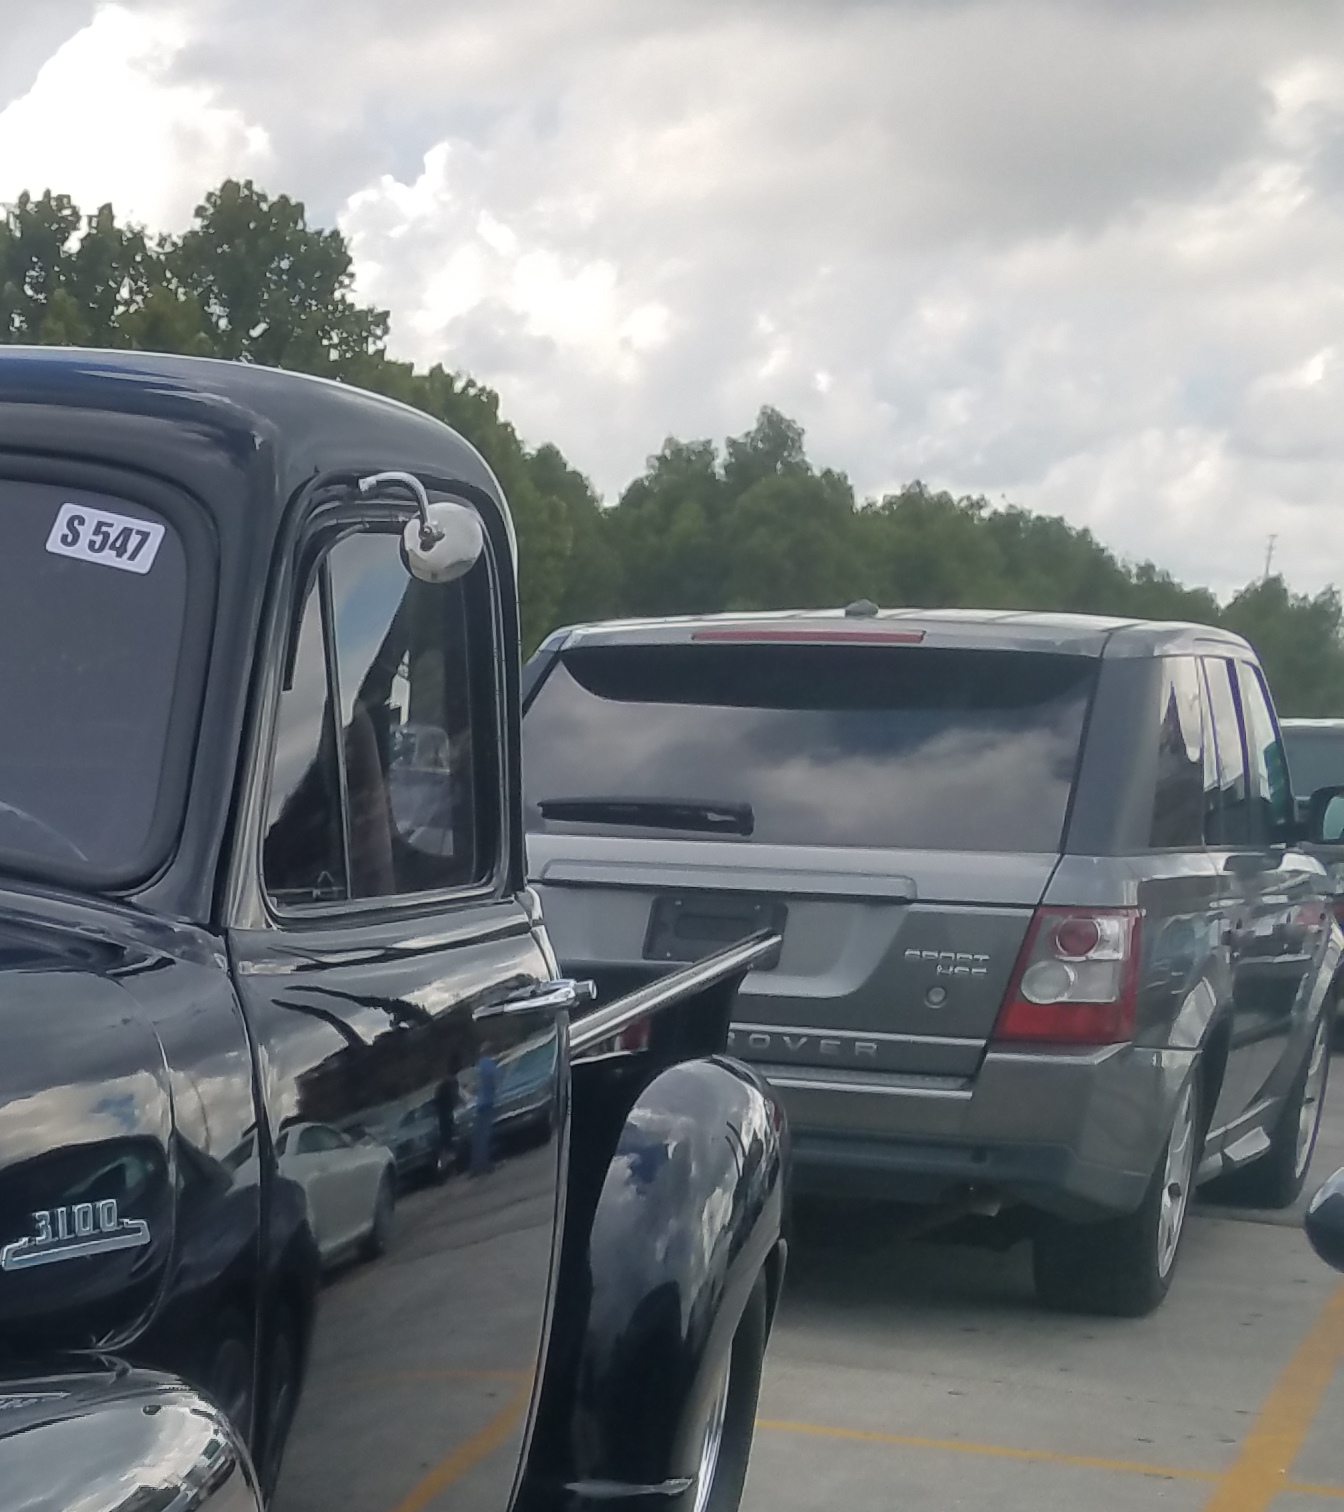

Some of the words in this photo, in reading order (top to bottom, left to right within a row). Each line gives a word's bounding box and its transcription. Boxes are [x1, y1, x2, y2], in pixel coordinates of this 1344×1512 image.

[60, 514, 86, 548] S
[87, 520, 151, 562] 547
[31, 1199, 120, 1246] 3100
